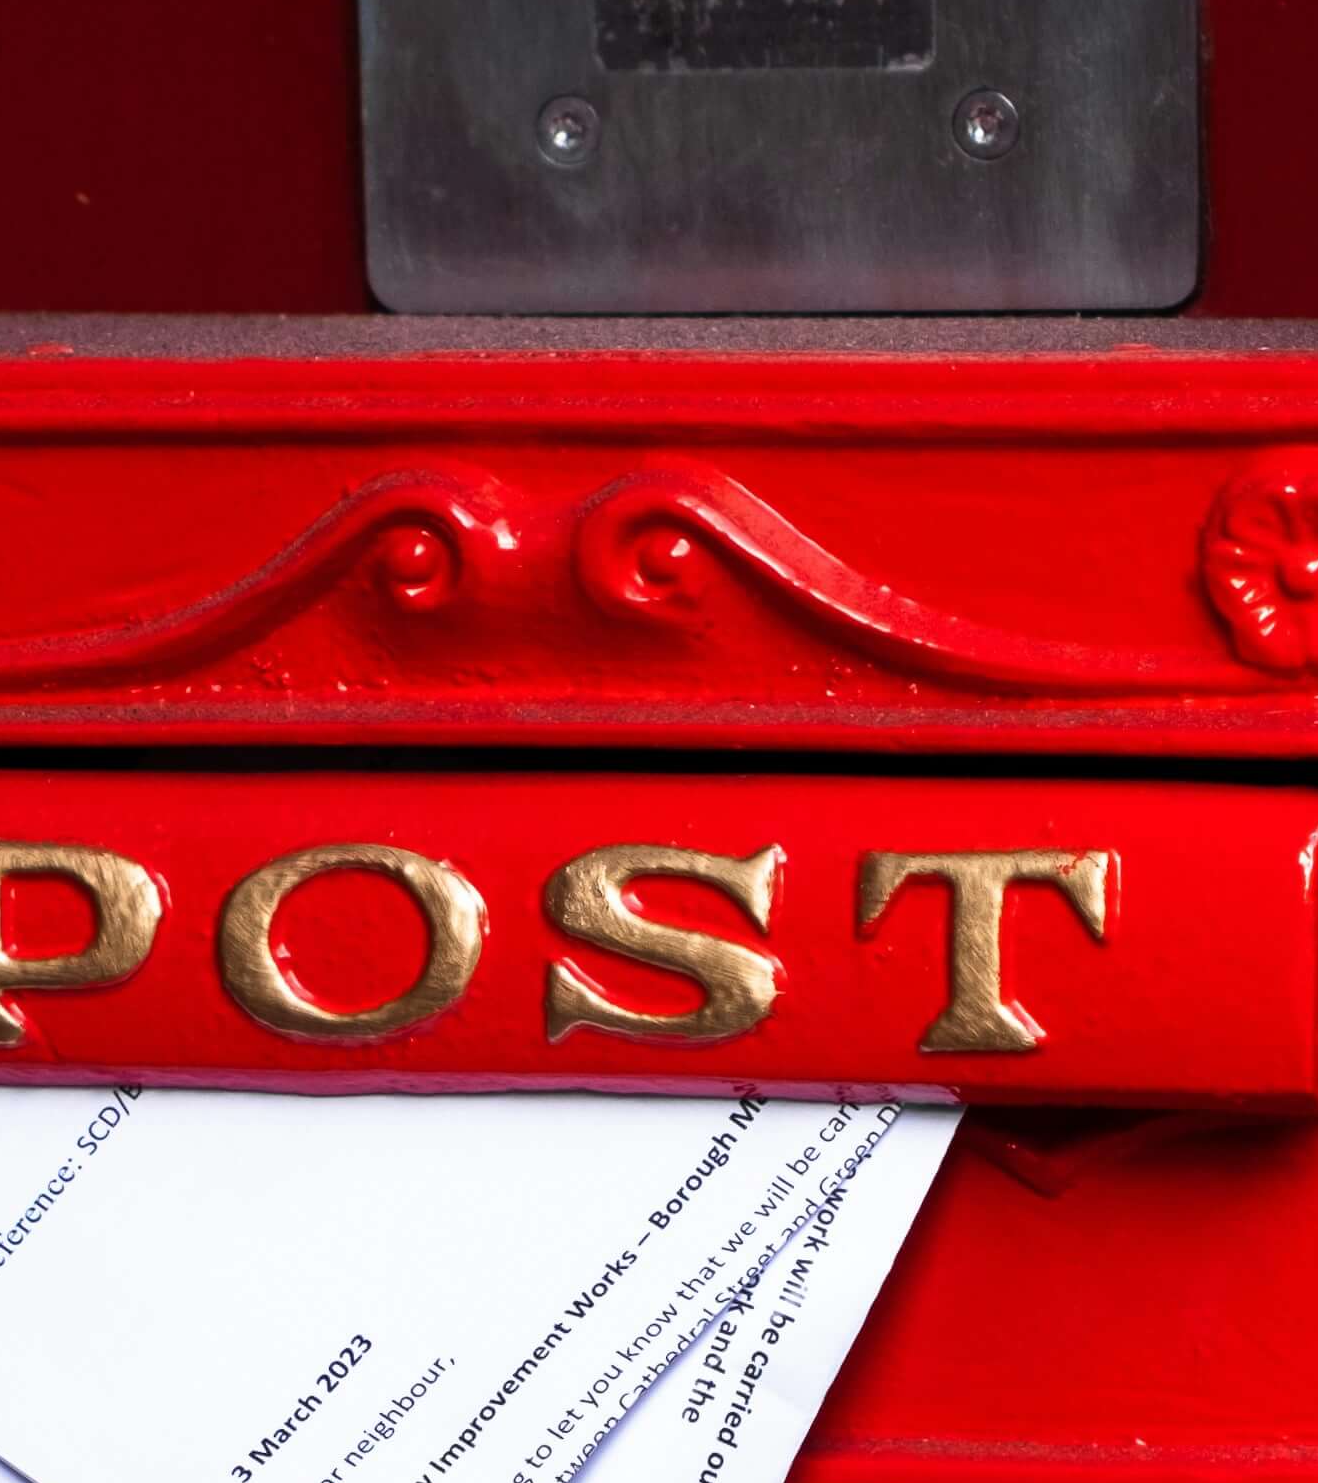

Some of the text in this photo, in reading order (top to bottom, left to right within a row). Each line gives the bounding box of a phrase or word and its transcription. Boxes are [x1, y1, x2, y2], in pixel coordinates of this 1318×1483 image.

[802, 1186, 849, 1252] work
[429, 1322, 572, 1475] Improvement
[565, 1249, 638, 1319] Works
[648, 1133, 738, 1230] Borough
[525, 1443, 553, 1469] to
[546, 1408, 584, 1441] let
[579, 1364, 624, 1408] you
[615, 1303, 678, 1362] know
[675, 1256, 727, 1301] that
[721, 1221, 758, 1254] we
[754, 1174, 795, 1218] will
[785, 1145, 822, 1177] be
[778, 1259, 814, 1309] will
[703, 1320, 738, 1374] and
[762, 1308, 796, 1346] be
[231, 1334, 373, 1483] 3 March 2023
[343, 1356, 456, 1467] neighbour,
[681, 1377, 717, 1424] the
[716, 1351, 770, 1450] carried
